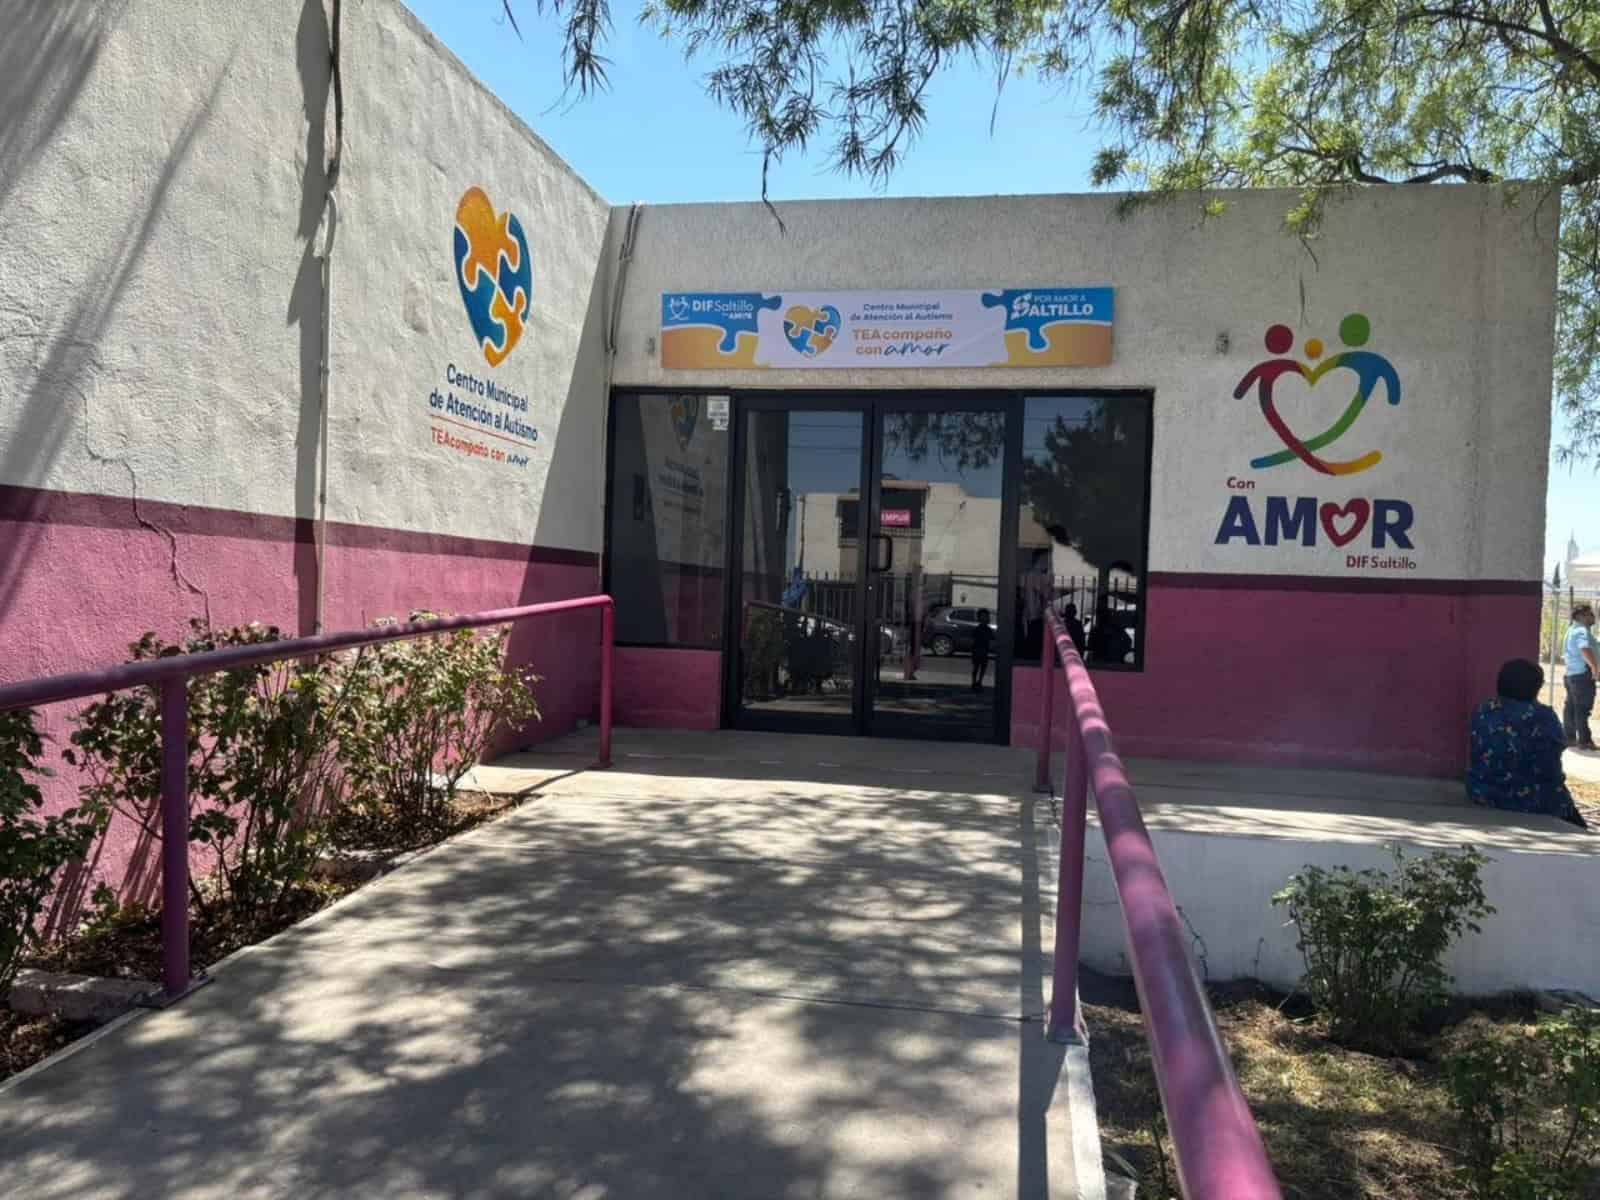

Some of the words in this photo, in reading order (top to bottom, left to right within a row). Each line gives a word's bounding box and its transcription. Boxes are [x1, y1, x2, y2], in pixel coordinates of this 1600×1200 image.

[692, 300, 714, 312] DIF
[714, 300, 754, 312] Saltillo
[863, 303, 894, 311] Centro
[896, 302, 940, 311] Municipal
[1034, 295, 1051, 303] POR
[863, 312, 903, 320] Atención
[905, 312, 913, 320] al
[856, 345, 882, 355] con
[884, 342, 950, 357] amor
[446, 364, 485, 395] Centro
[486, 380, 528, 411] Municipal
[430, 388, 443, 409] de
[446, 392, 492, 425] Atención
[494, 412, 502, 429] al
[504, 412, 538, 441] Autismo
[431, 427, 489, 457] TEAcompaño
[491, 449, 505, 461] con
[1226, 476, 1256, 489] Con
[1214, 495, 1415, 550] AMOR
[1346, 555, 1369, 569] DIF
[1371, 556, 1417, 570] Saltillo
